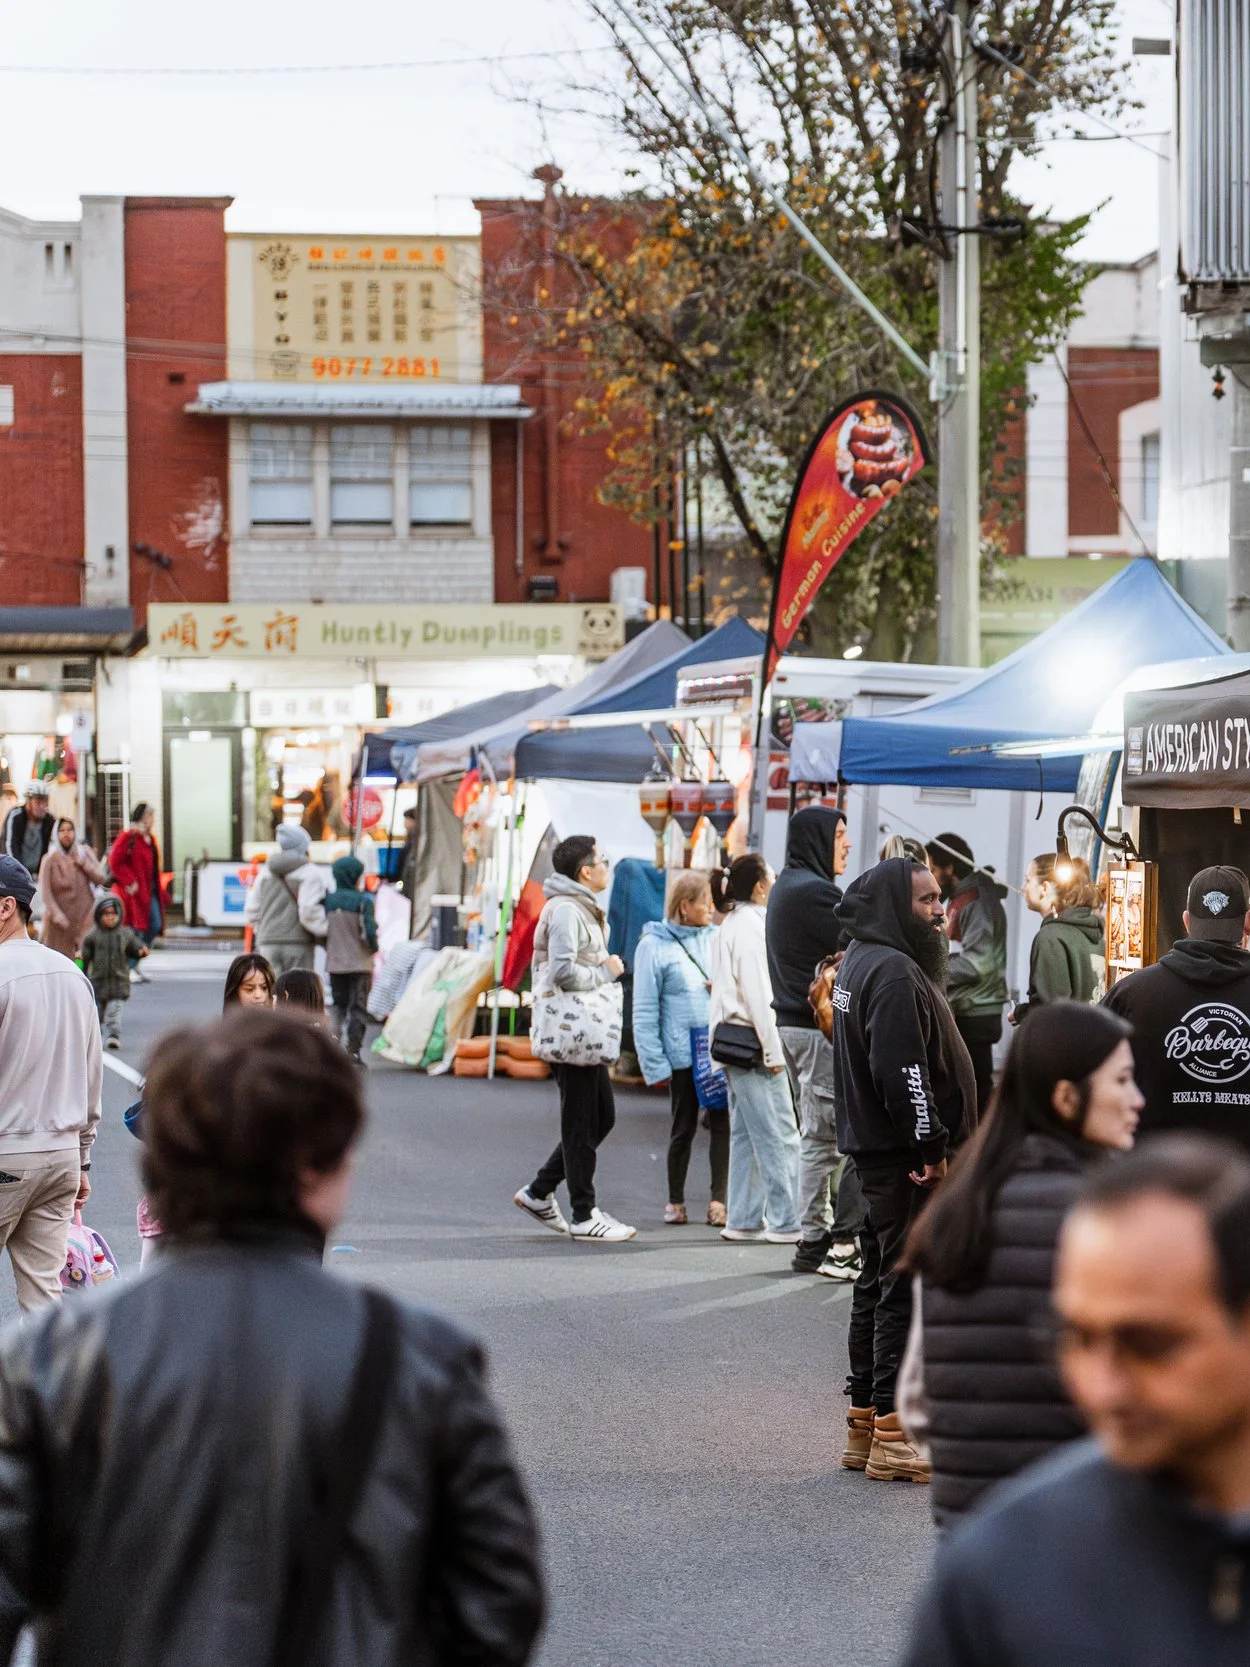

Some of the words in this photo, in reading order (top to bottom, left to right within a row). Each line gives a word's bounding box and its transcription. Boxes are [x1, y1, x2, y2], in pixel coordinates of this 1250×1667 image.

[312, 356, 373, 378] 9077
[381, 356, 440, 378] 2881
[781, 560, 822, 630] German
[821, 502, 866, 557] Cuisine
[161, 611, 300, 653] 順天府
[322, 620, 412, 649] Huntly
[421, 620, 564, 650] Dumplings
[1145, 719, 1219, 773] AMERICAN
[1208, 1008, 1244, 1026] VICTORIAN
[1188, 1062, 1218, 1078] ALLIANCE
[1172, 1091, 1213, 1105] KELLYS
[1214, 1092, 1250, 1106] MEATS
